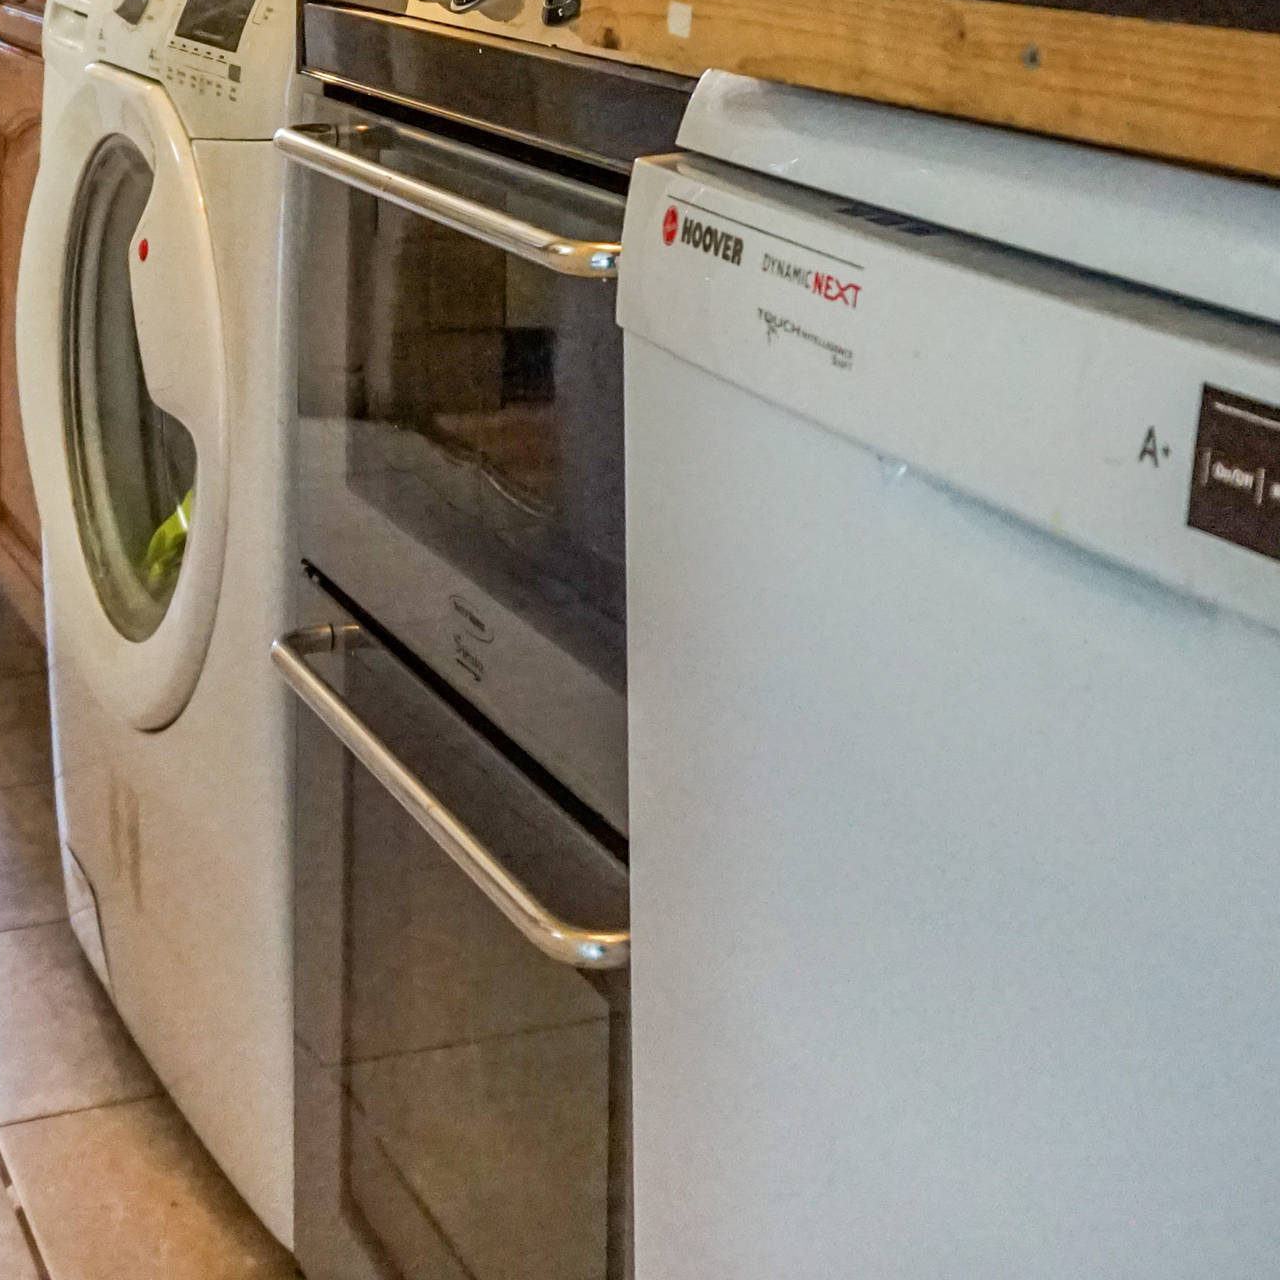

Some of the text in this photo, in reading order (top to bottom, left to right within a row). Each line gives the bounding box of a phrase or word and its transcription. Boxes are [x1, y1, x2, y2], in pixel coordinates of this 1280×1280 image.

[681, 217, 744, 265] HOOVER
[812, 271, 862, 309] NEXT
[757, 307, 801, 337] TOUCH
